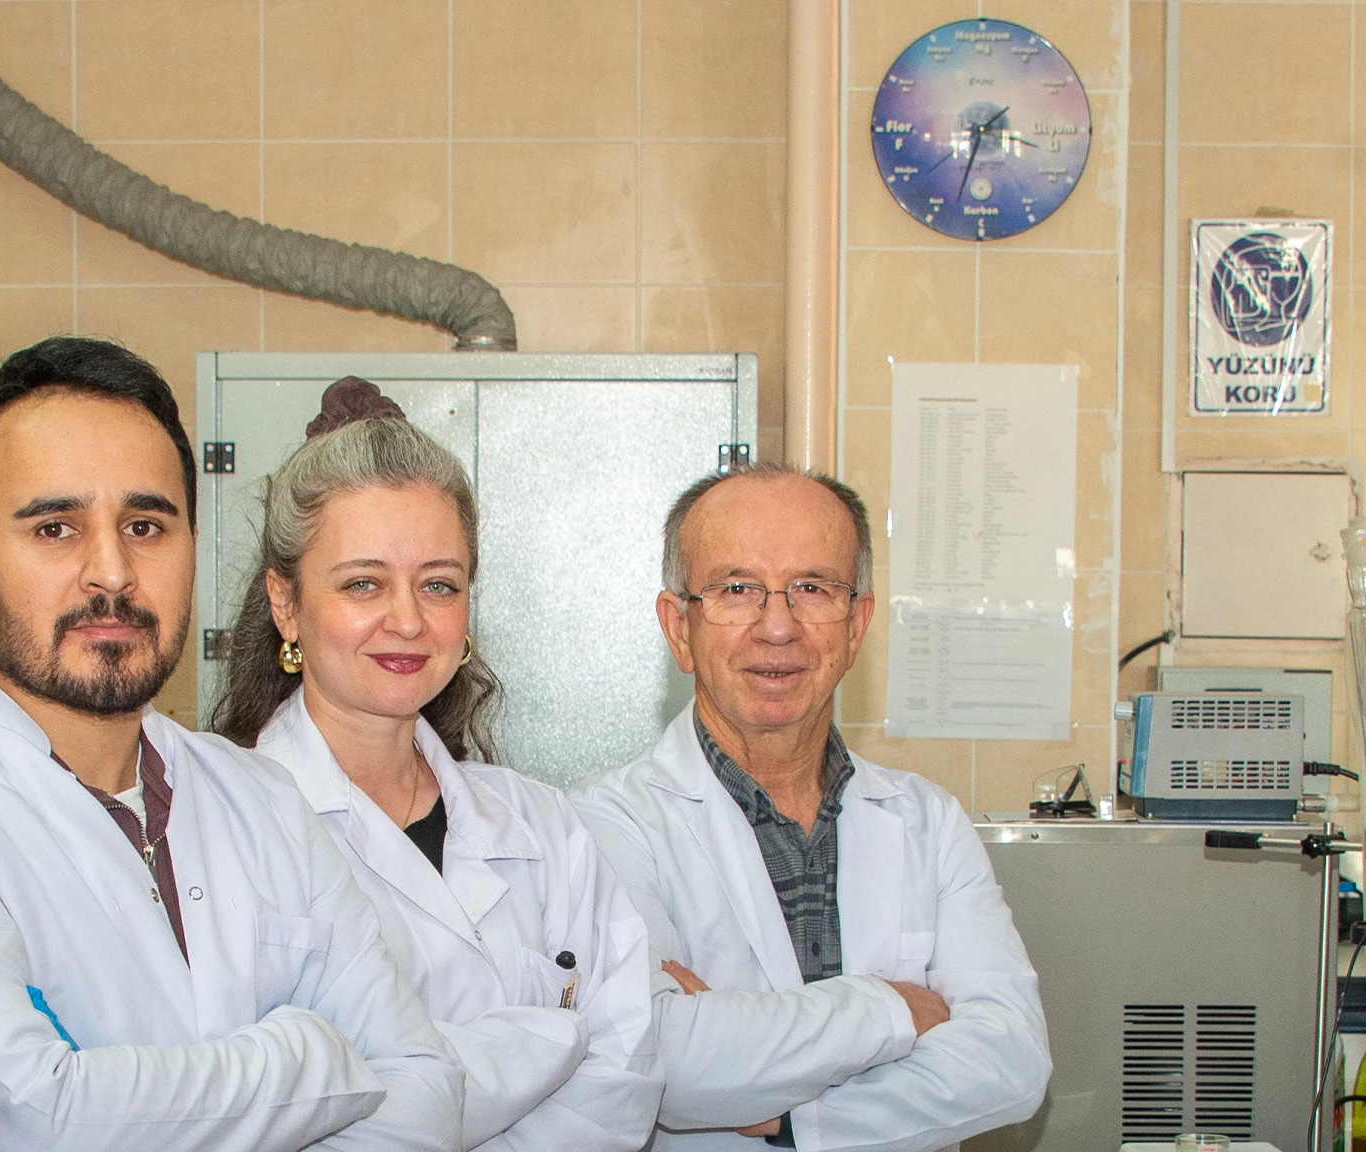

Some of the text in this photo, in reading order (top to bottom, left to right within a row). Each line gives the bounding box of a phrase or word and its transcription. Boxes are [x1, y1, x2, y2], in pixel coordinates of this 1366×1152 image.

[886, 120, 913, 133] Flor
[1207, 353, 1315, 375] YÜZÜNÜ
[1225, 385, 1296, 403] KORU
